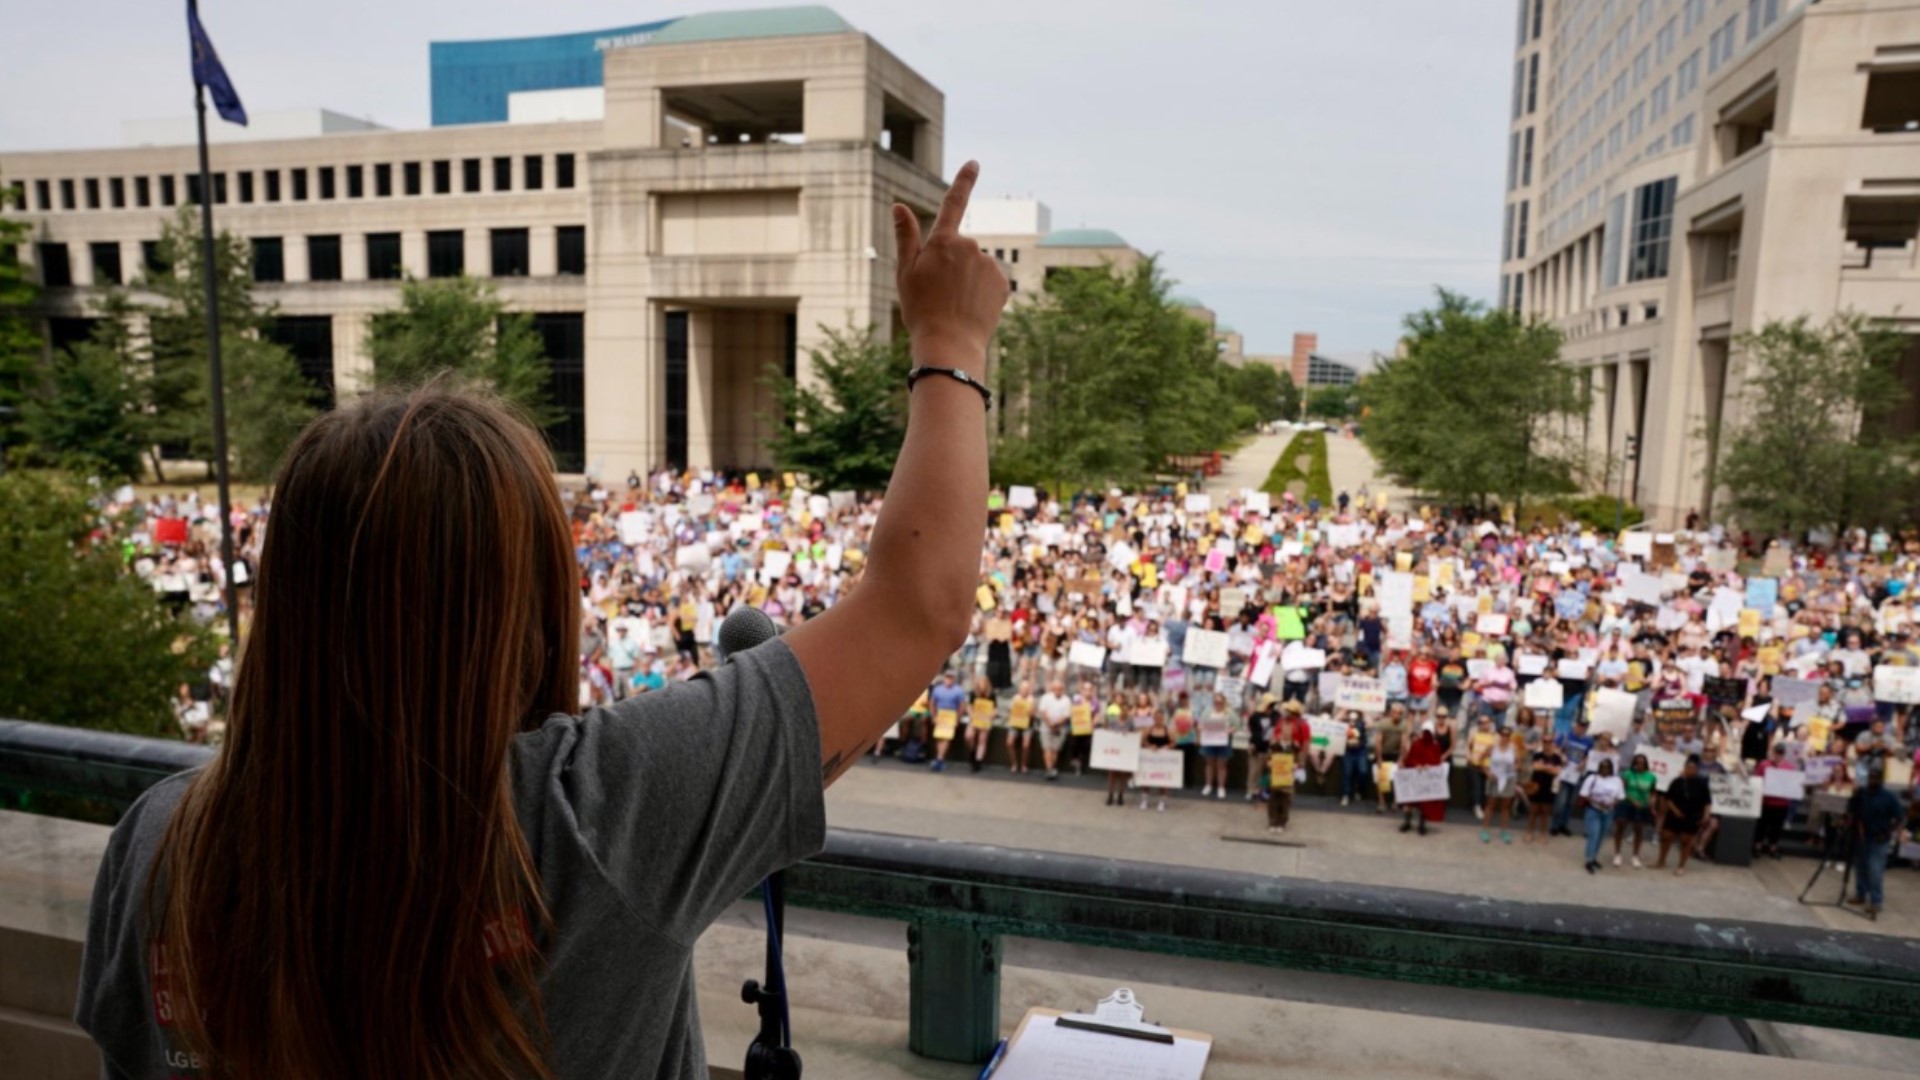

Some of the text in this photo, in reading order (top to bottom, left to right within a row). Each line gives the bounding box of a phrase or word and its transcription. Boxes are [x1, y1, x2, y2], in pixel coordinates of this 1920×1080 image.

[1342, 678, 1381, 690] TRUST
[1341, 692, 1383, 703] WOMEN
[1719, 796, 1752, 809] WOMEN
